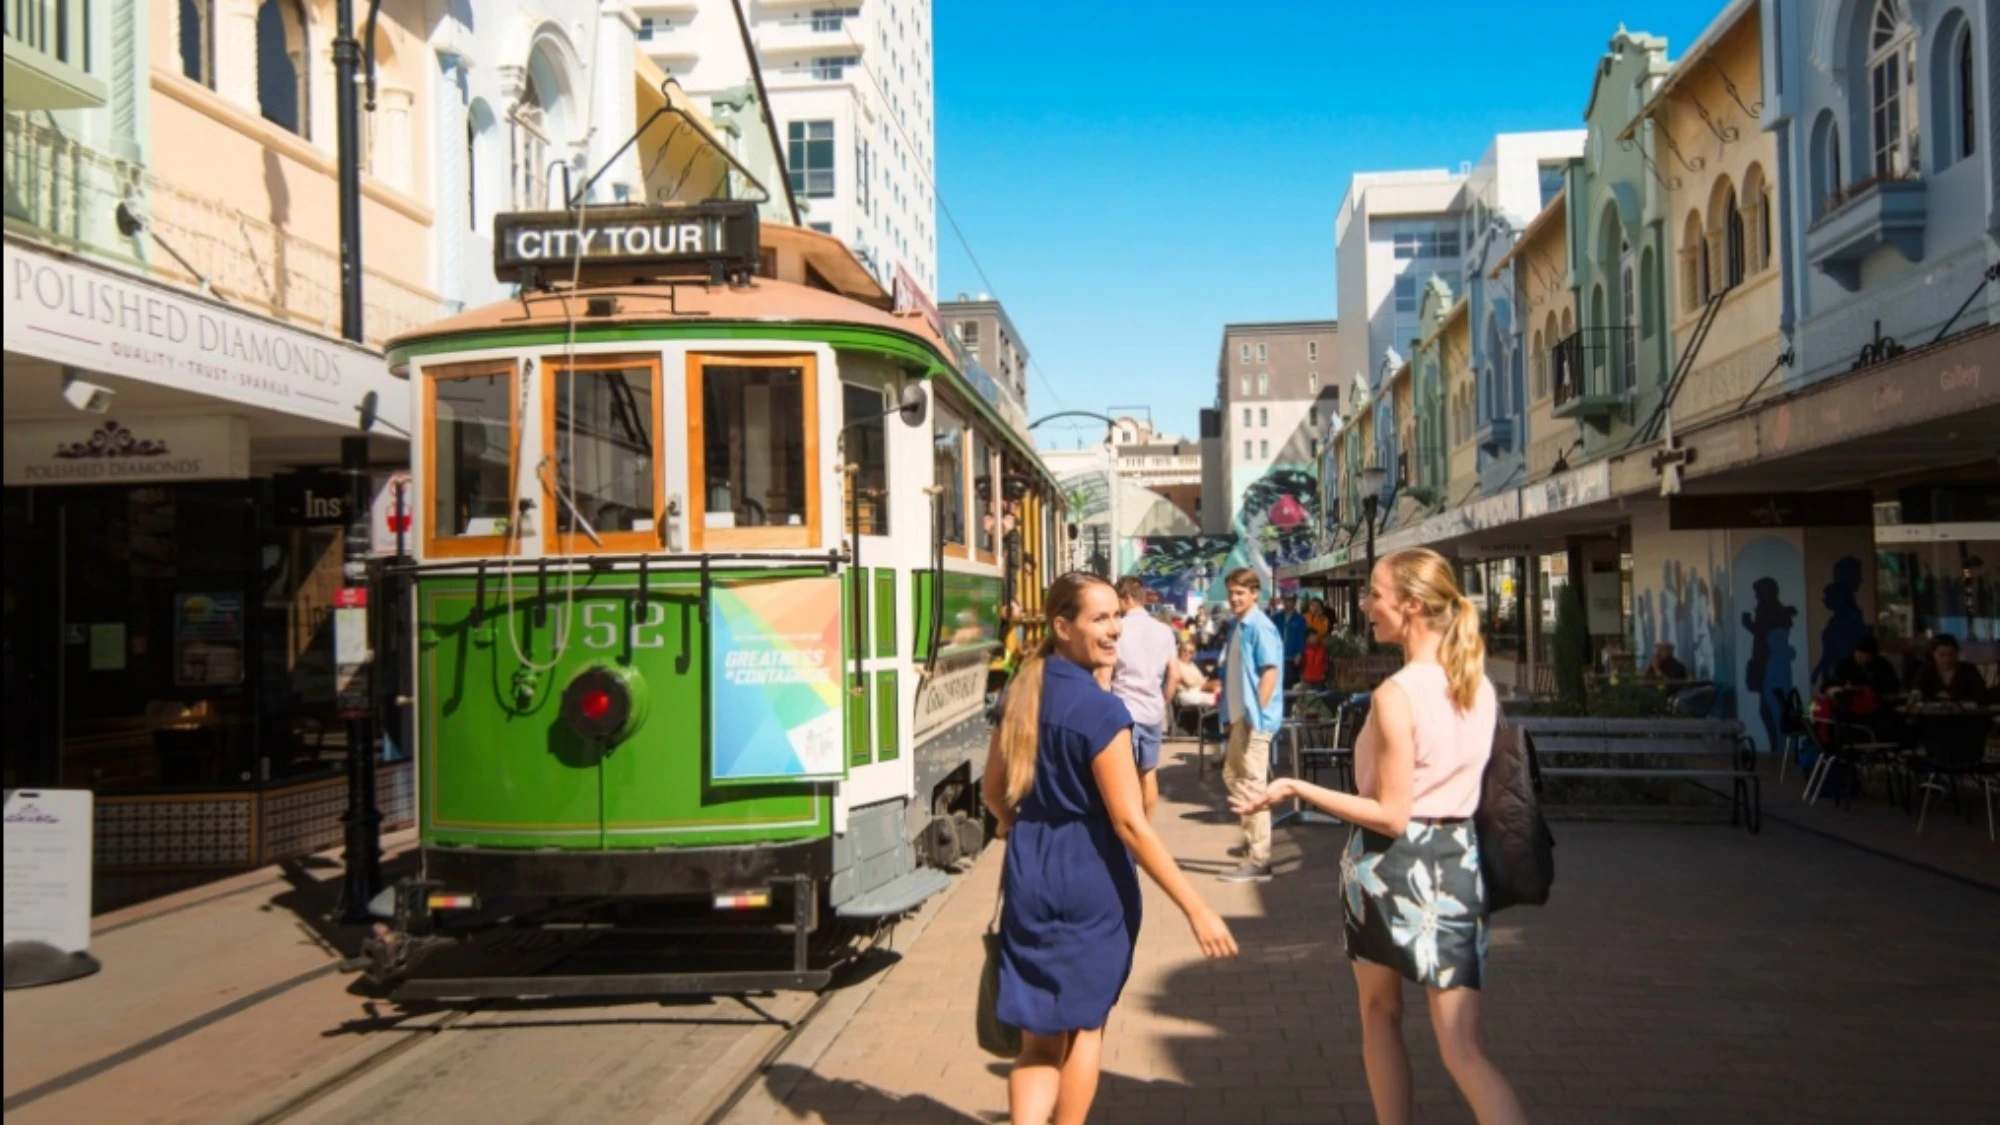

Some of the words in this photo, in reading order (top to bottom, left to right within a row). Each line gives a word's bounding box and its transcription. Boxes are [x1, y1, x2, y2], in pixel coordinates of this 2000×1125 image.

[516, 230, 597, 259] CITY
[605, 225, 703, 256] TOUR
[13, 257, 190, 344] POLISHED
[198, 312, 342, 387] DIAMONDS
[111, 341, 175, 368] QUALITY
[188, 360, 228, 382] TRUST
[239, 373, 290, 397] SPARKLE
[25, 463, 105, 479] POLISHED
[109, 458, 200, 476] DIAMONDS
[547, 601, 665, 650] 152
